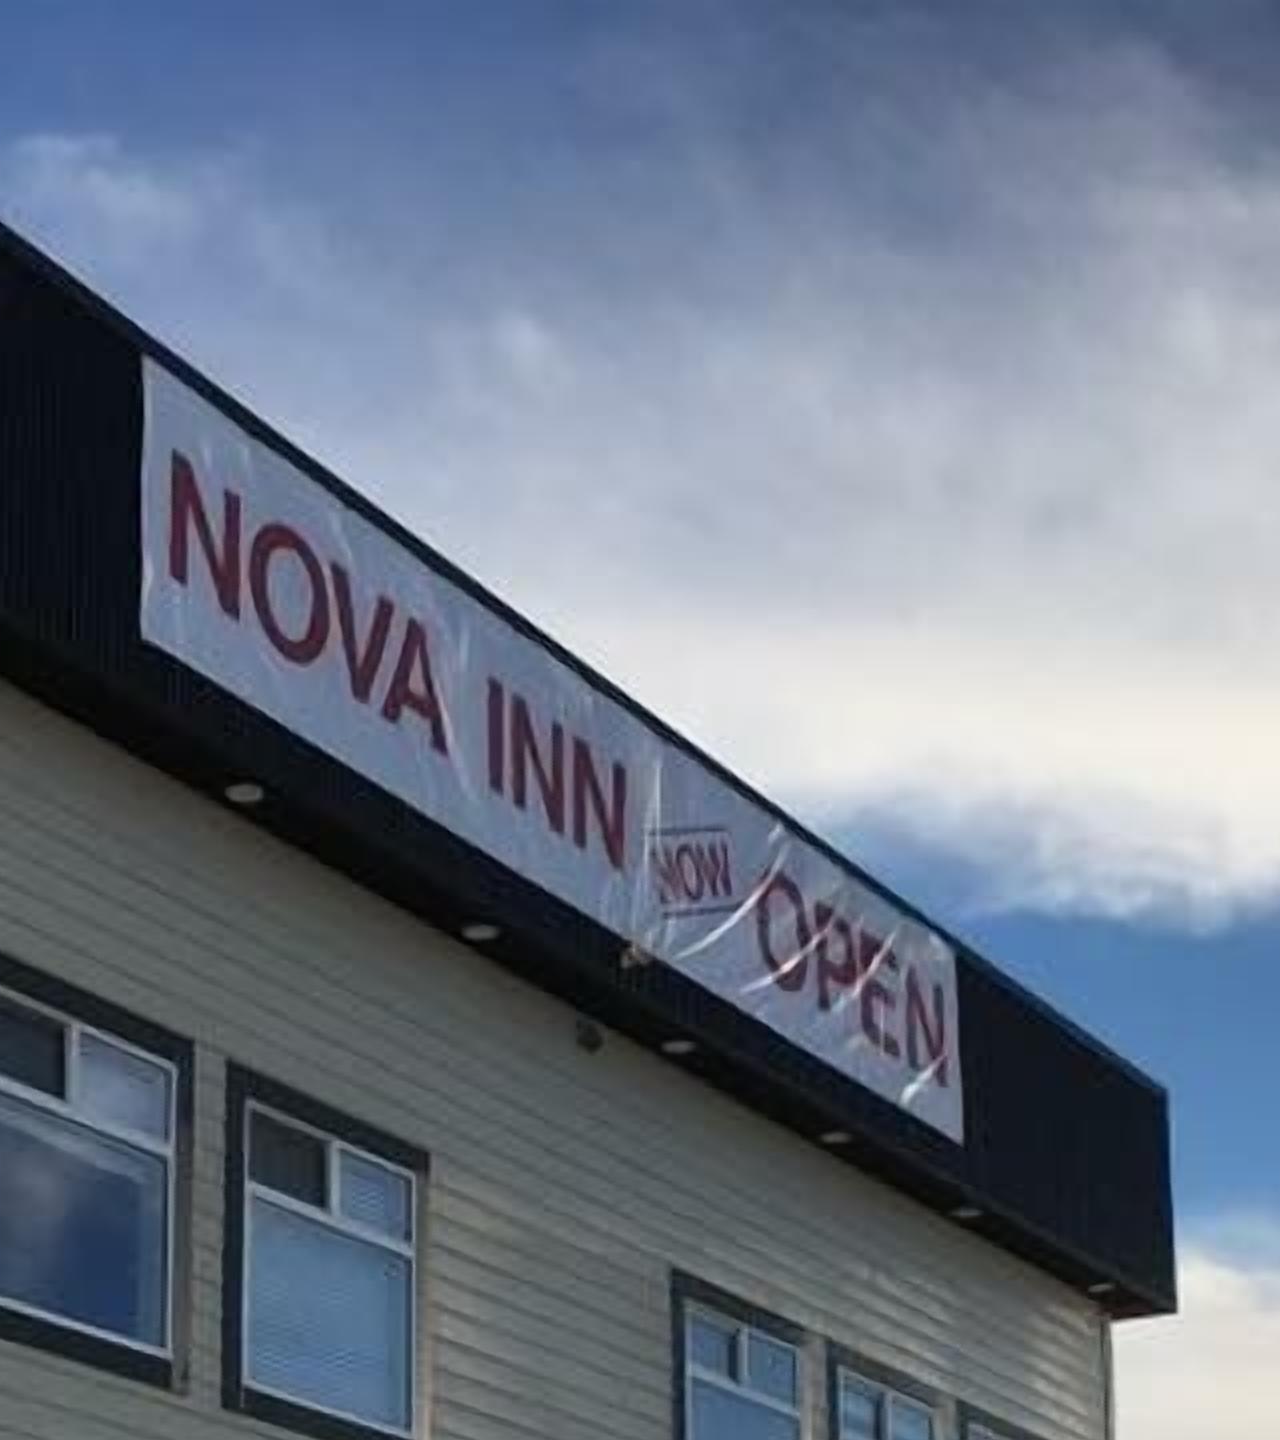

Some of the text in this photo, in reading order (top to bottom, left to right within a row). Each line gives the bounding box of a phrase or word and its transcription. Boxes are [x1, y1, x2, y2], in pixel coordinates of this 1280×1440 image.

[169, 448, 627, 870] NOVA INN
[651, 843, 732, 904] NOW
[755, 868, 948, 1088] OPEN
